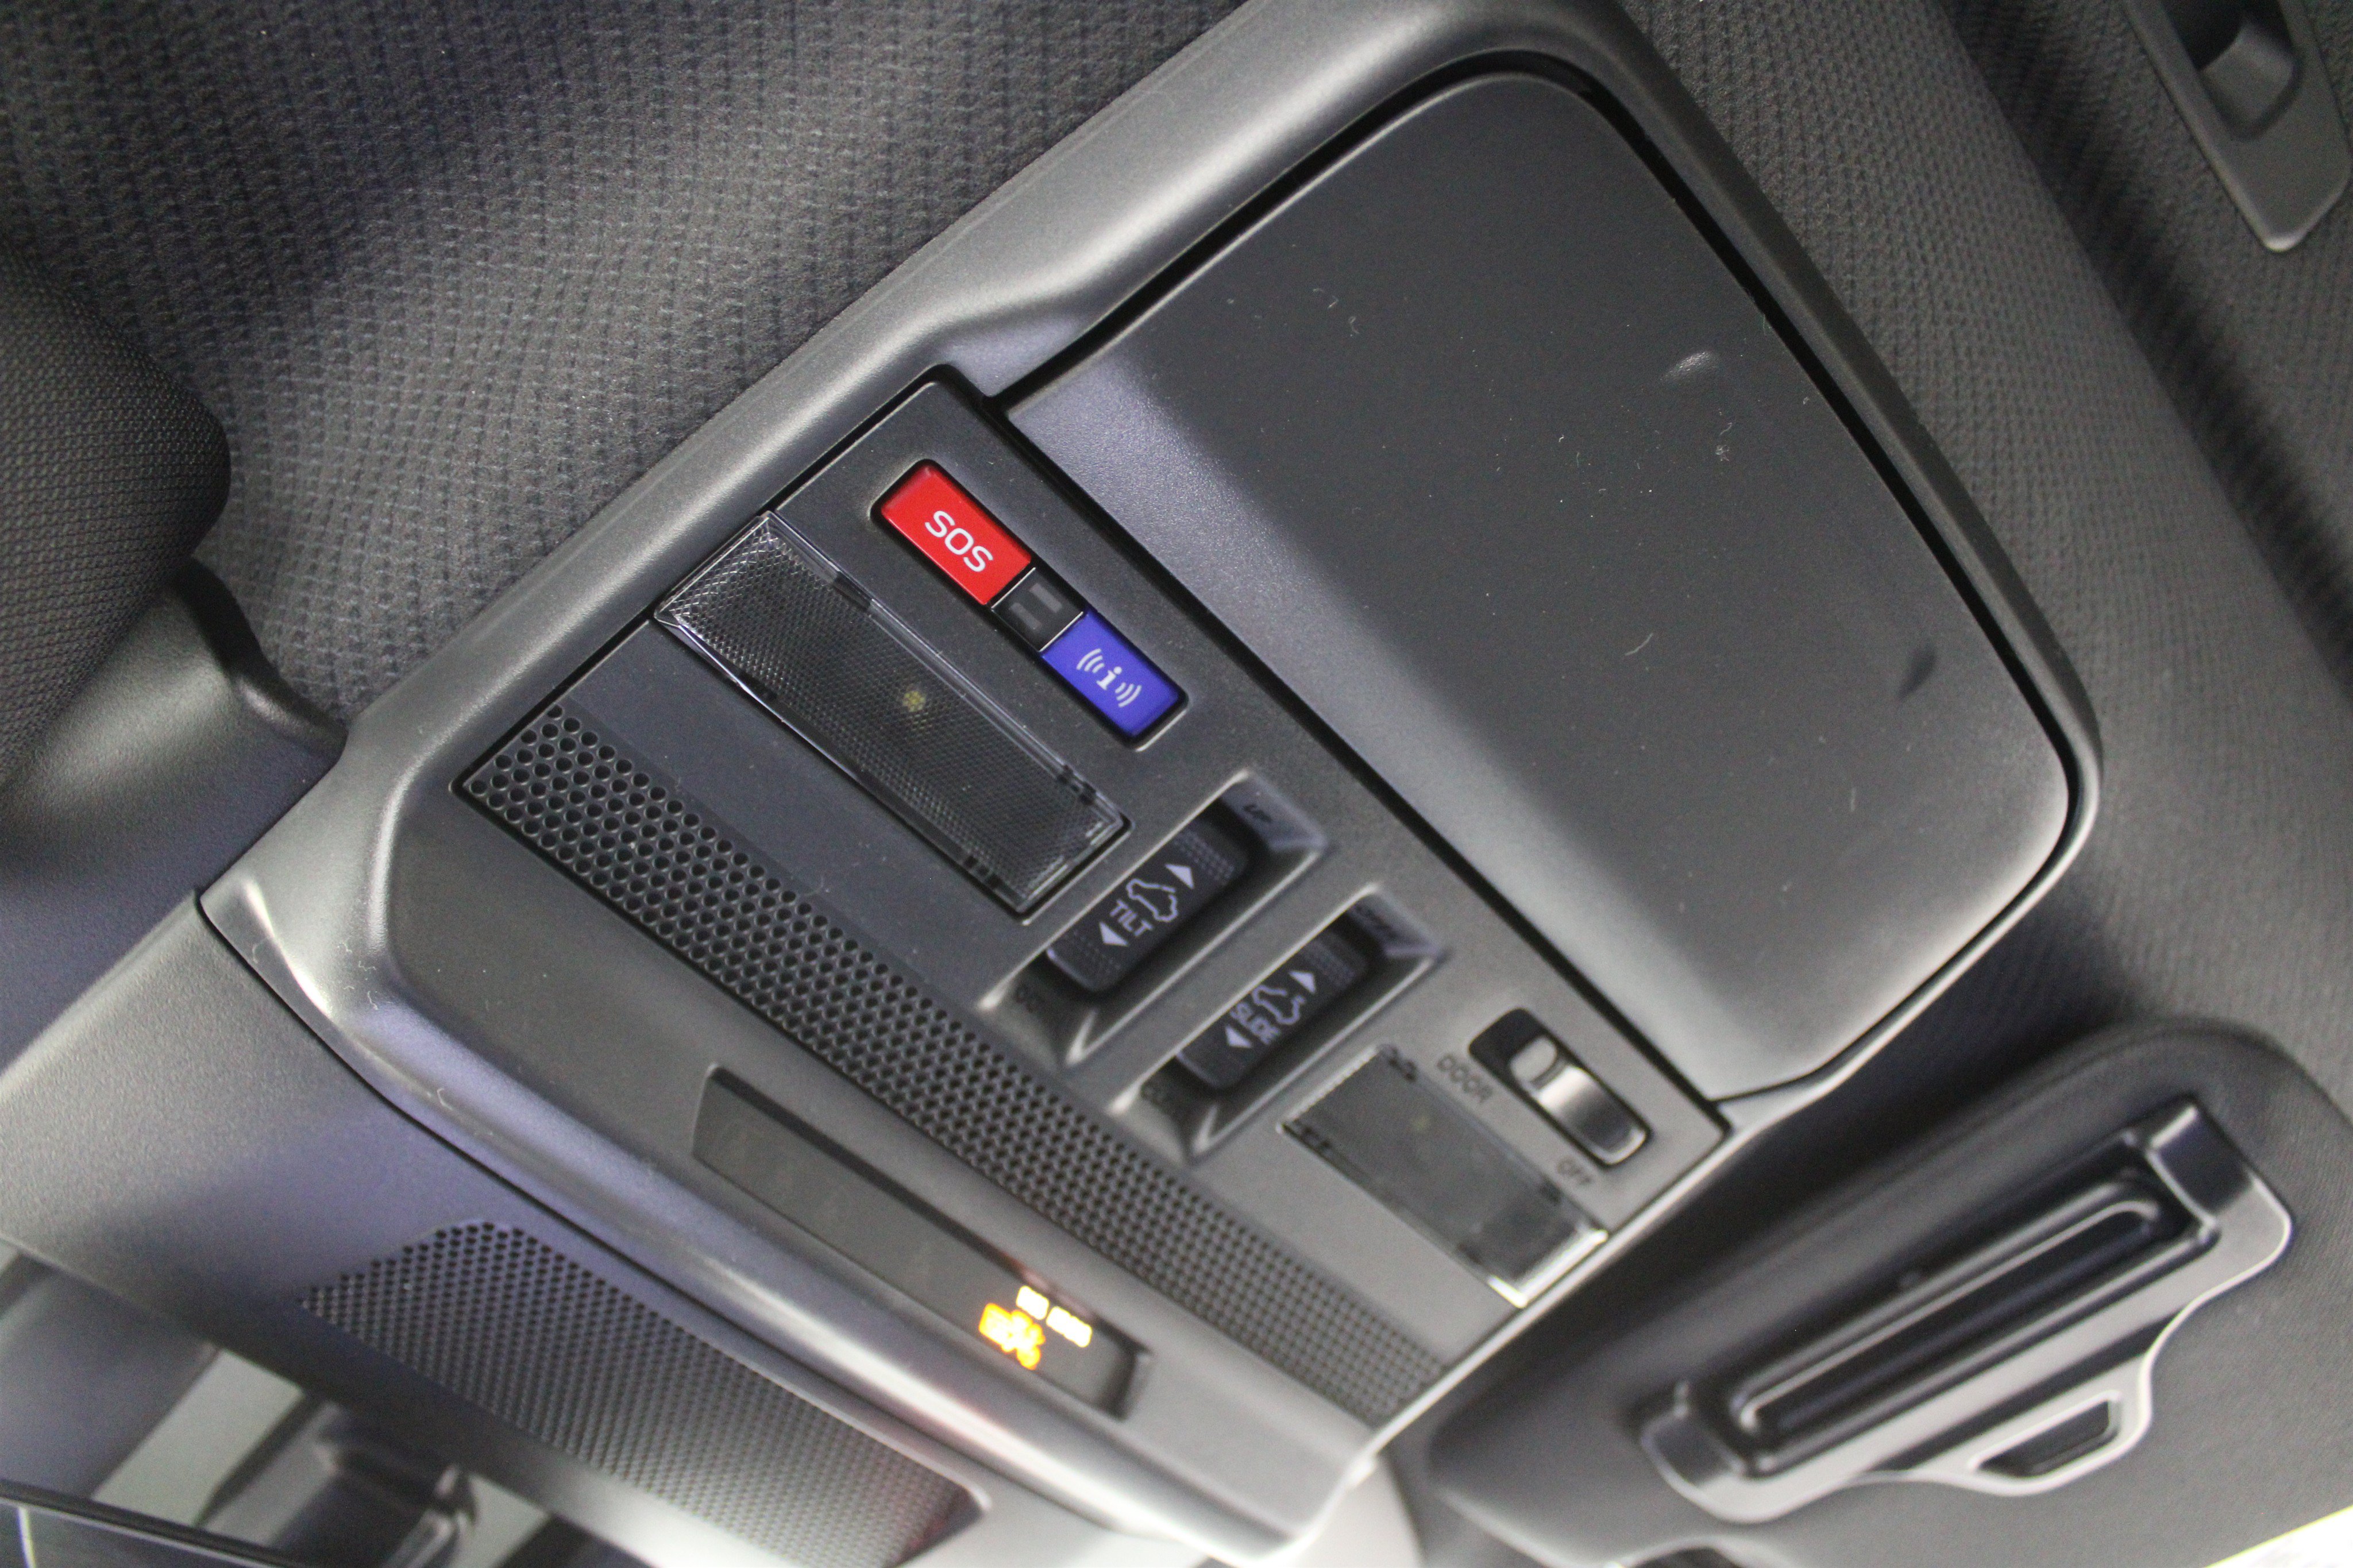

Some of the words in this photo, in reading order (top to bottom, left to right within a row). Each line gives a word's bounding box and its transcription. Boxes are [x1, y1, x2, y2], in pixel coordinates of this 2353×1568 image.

[925, 510, 994, 573] SOS
[1109, 898, 1153, 937] TILT
[1229, 1002, 1280, 1044] SLIDE
[1437, 1055, 1492, 1103] DOOR
